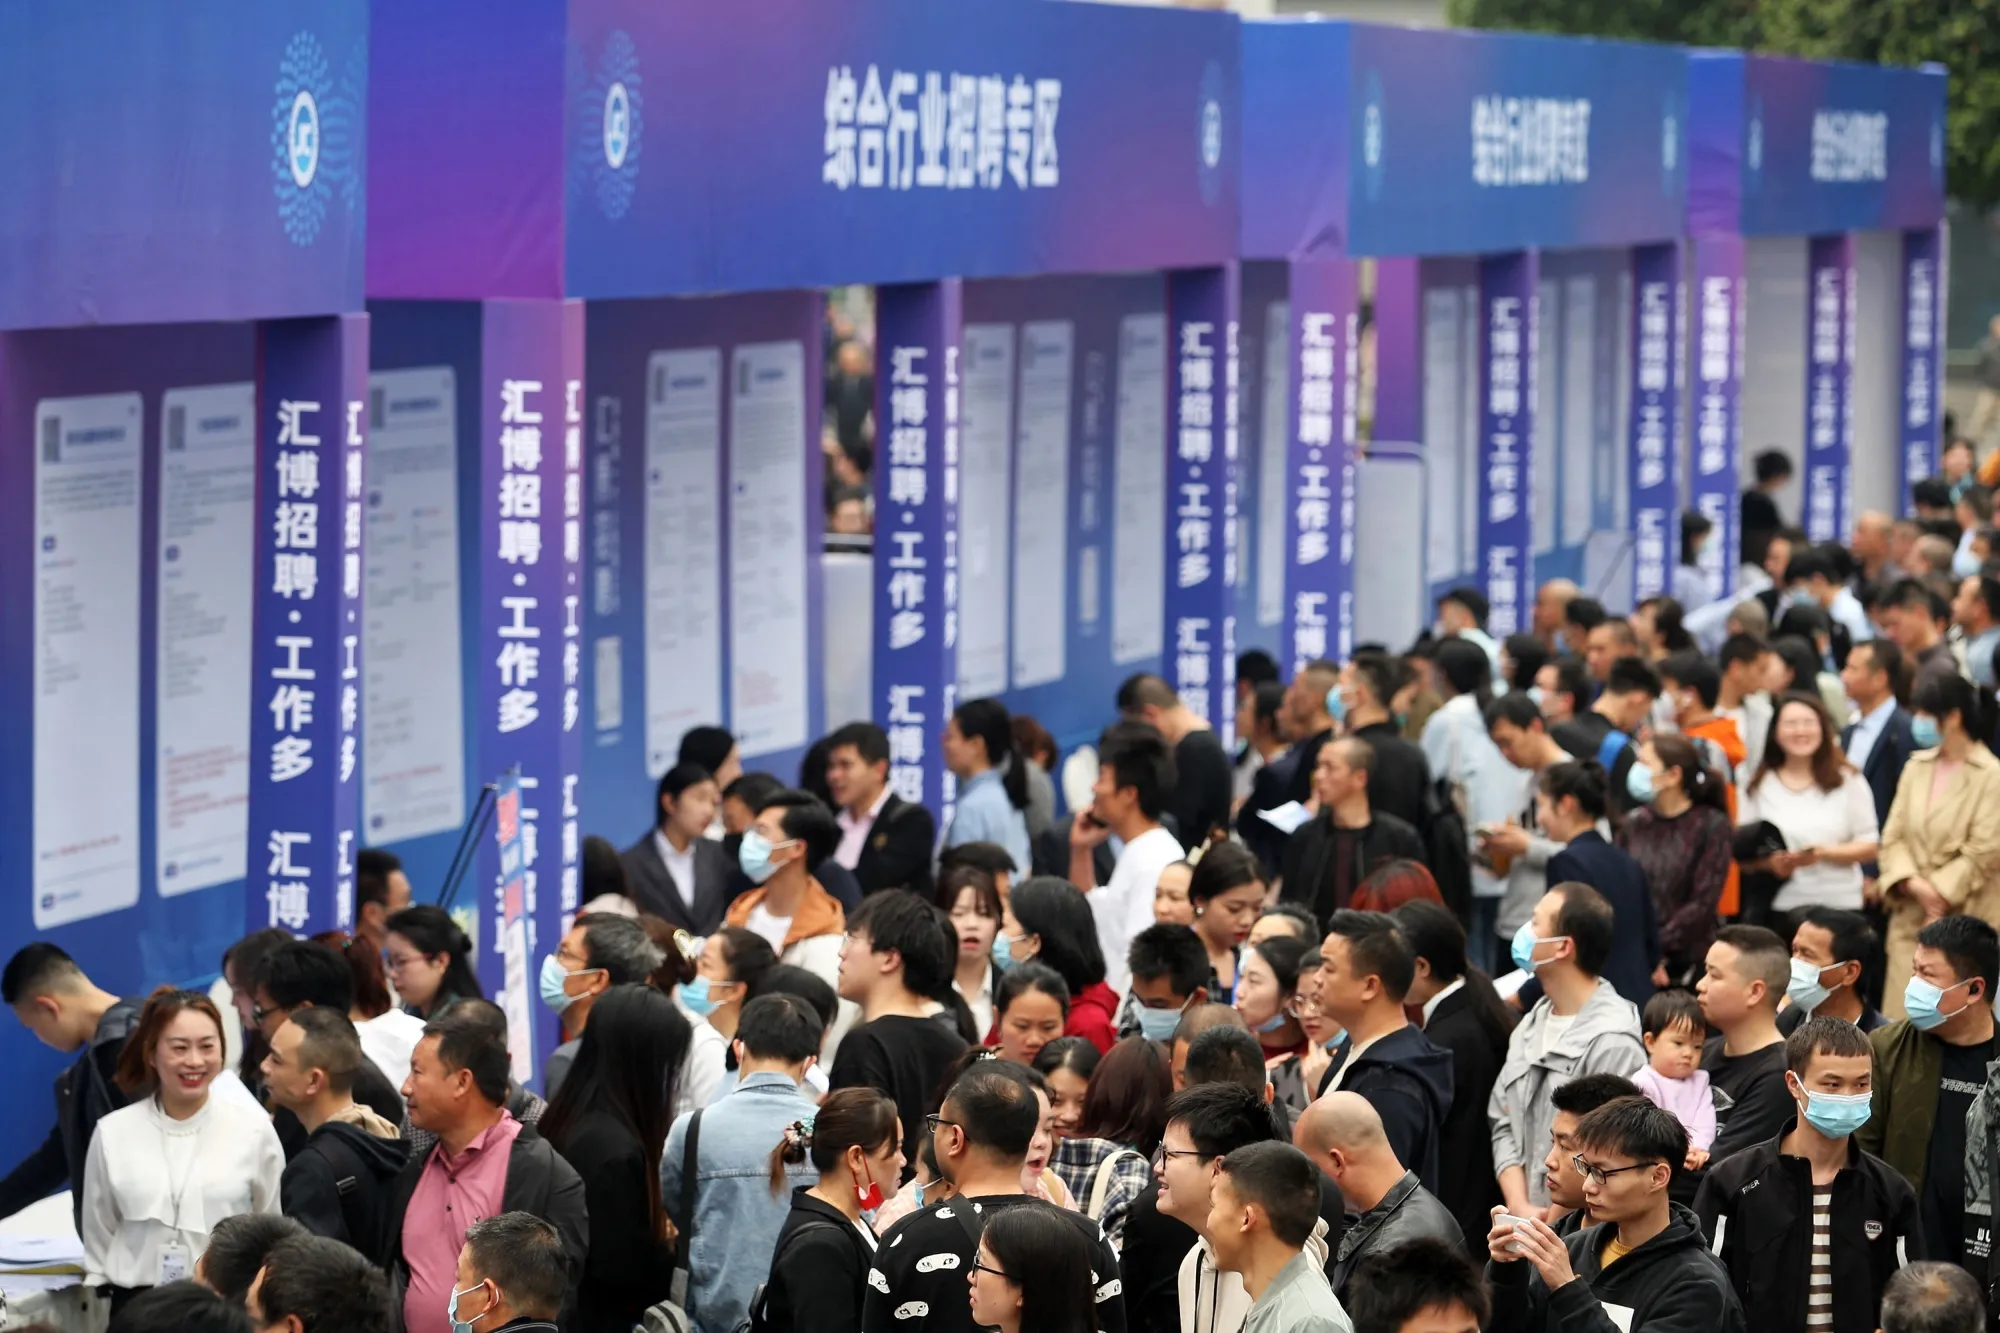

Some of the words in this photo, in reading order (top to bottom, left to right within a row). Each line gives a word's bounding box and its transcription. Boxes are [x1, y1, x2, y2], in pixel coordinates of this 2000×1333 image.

[823, 64, 1062, 190] 综合行业招聘专区
[269, 399, 321, 783] 汇博招聘·工作多
[497, 379, 543, 733] 汇博招聘·工作多
[266, 830, 312, 941] 汇博
